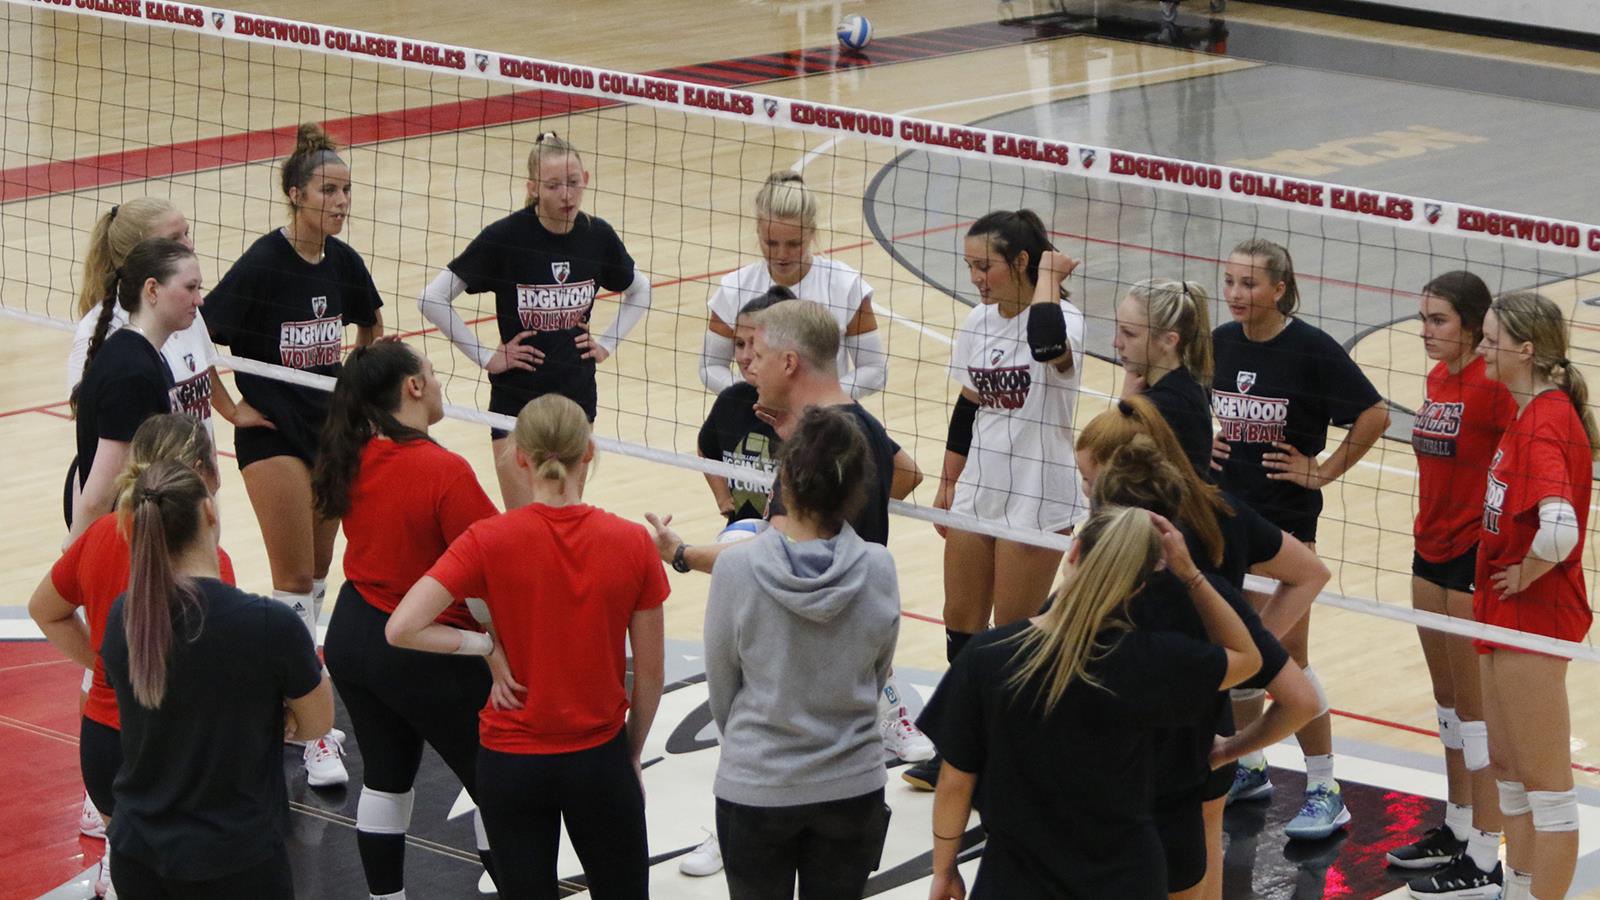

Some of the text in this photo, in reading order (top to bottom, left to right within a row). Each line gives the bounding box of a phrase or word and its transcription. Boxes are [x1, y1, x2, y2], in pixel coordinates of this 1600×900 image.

[145, 1, 205, 28] EAGLES
[234, 15, 466, 70] EDGEWOOD COLLEGE EAGLES
[499, 57, 754, 116] EDGEWOOD COLLEGE EAGLES
[790, 103, 1069, 166] EDGEWOOD COLLEGE EAGLES
[1110, 152, 1414, 222] EDGEWOOD COLLEGE EAGLES
[1457, 208, 1581, 249] EDGEWOOD
